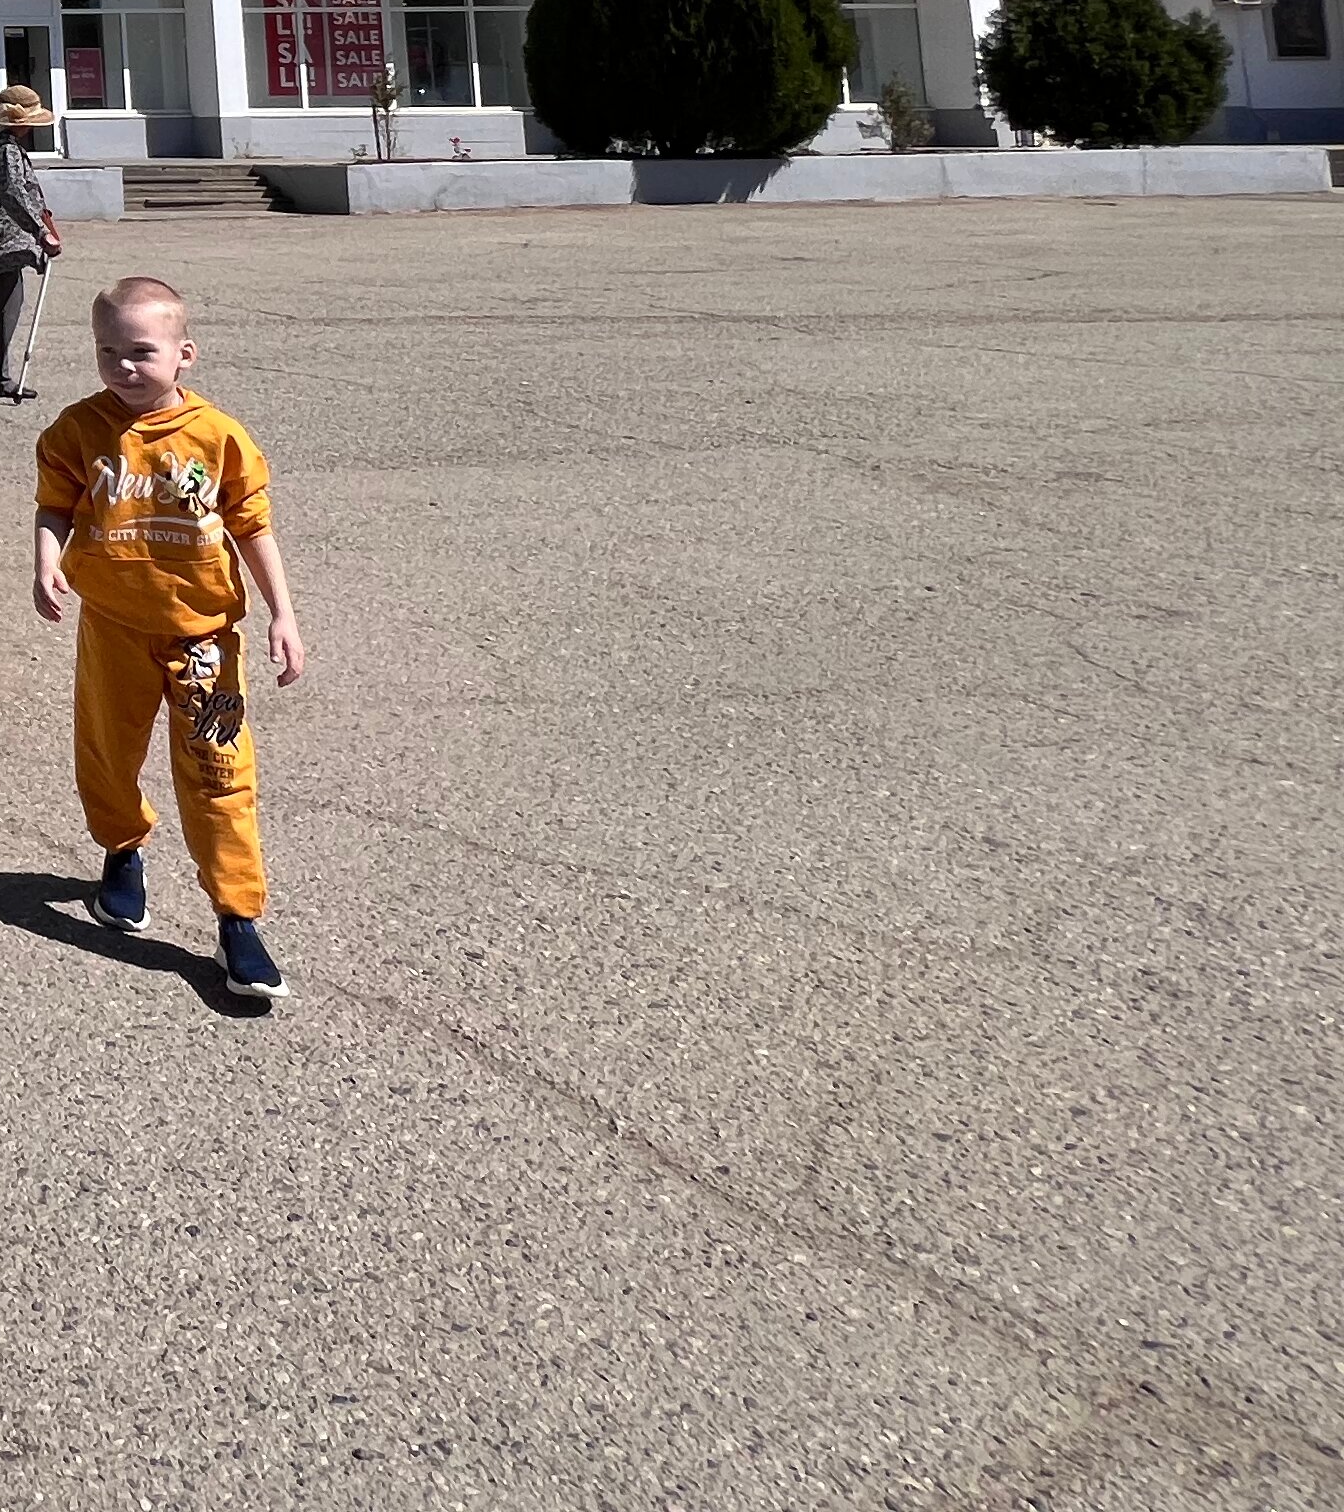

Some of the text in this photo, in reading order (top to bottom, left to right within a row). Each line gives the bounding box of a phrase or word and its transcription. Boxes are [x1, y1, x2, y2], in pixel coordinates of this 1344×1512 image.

[333, 11, 379, 25] SALE
[334, 30, 380, 45] SALE
[336, 50, 382, 65] SALE
[91, 454, 154, 506] New
[108, 528, 138, 542] CITY
[143, 530, 191, 546] NEVER
